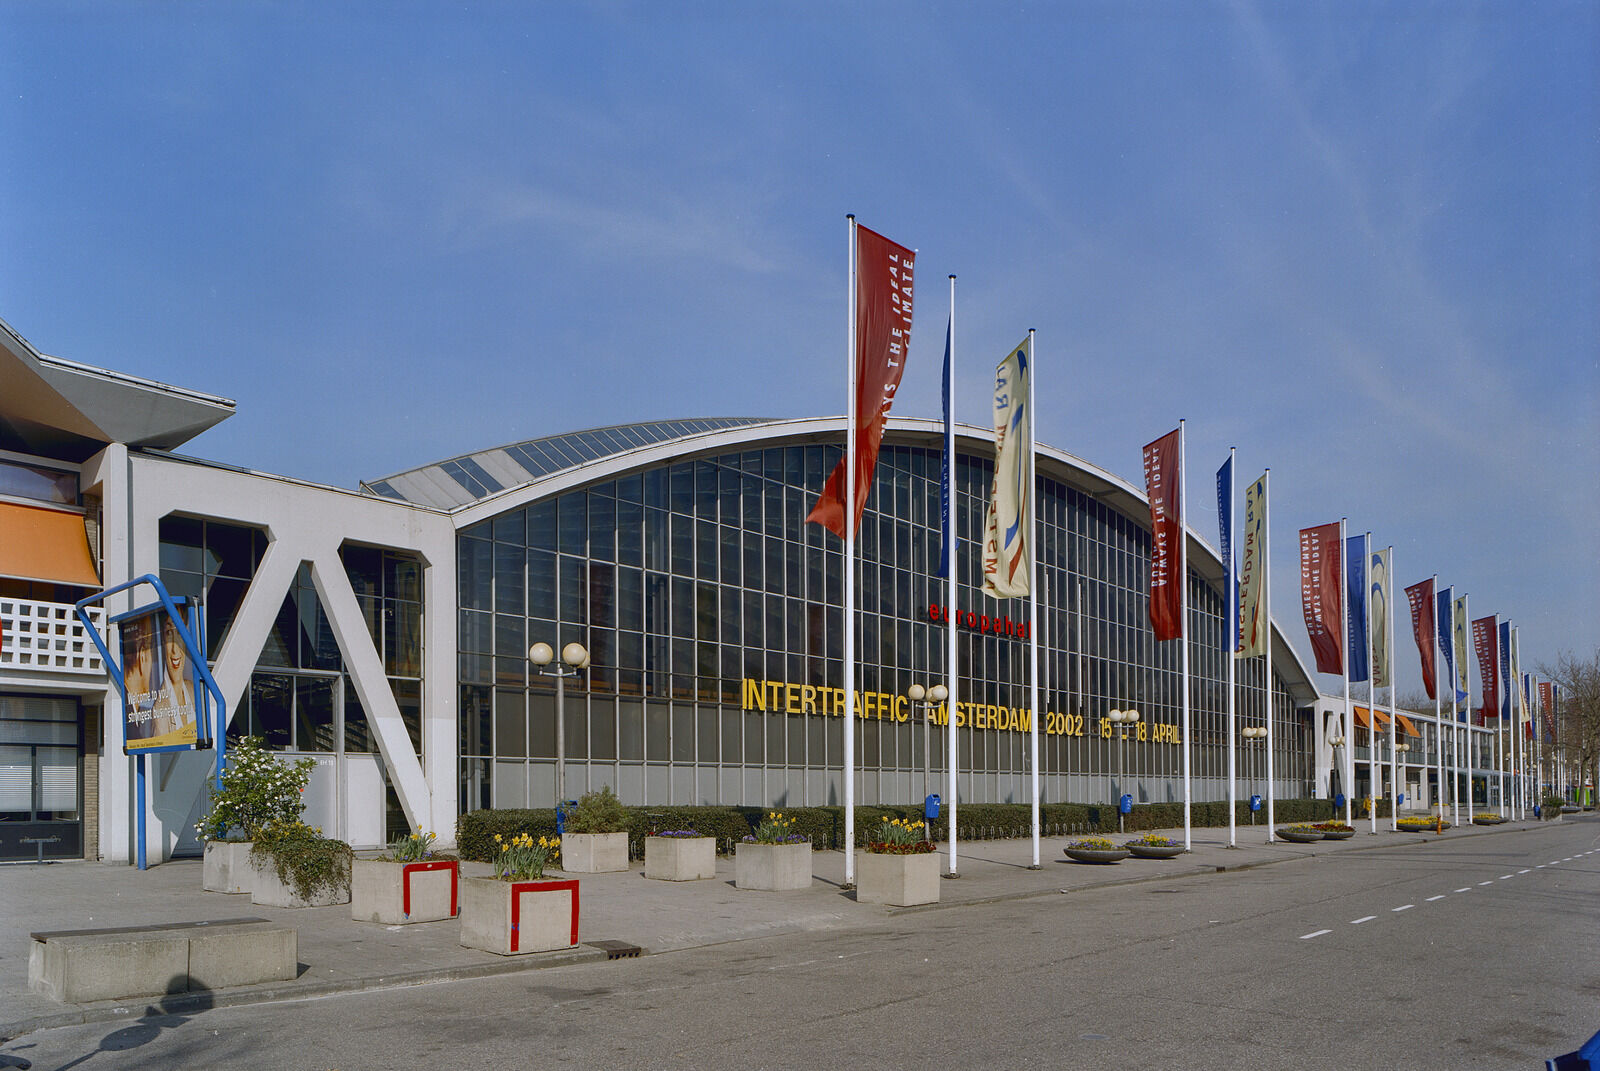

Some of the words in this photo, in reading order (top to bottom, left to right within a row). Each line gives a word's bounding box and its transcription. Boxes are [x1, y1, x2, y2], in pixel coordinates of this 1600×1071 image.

[889, 254, 901, 314] IDEAL
[887, 327, 902, 368] THE
[742, 678, 908, 722] INTERTRAFFIC
[927, 701, 1032, 732] AMSTERDAM
[1046, 711, 1083, 736] 2002
[1099, 717, 1112, 739] 15
[1135, 721, 1147, 742] 18
[1152, 723, 1181, 744] APRIL
